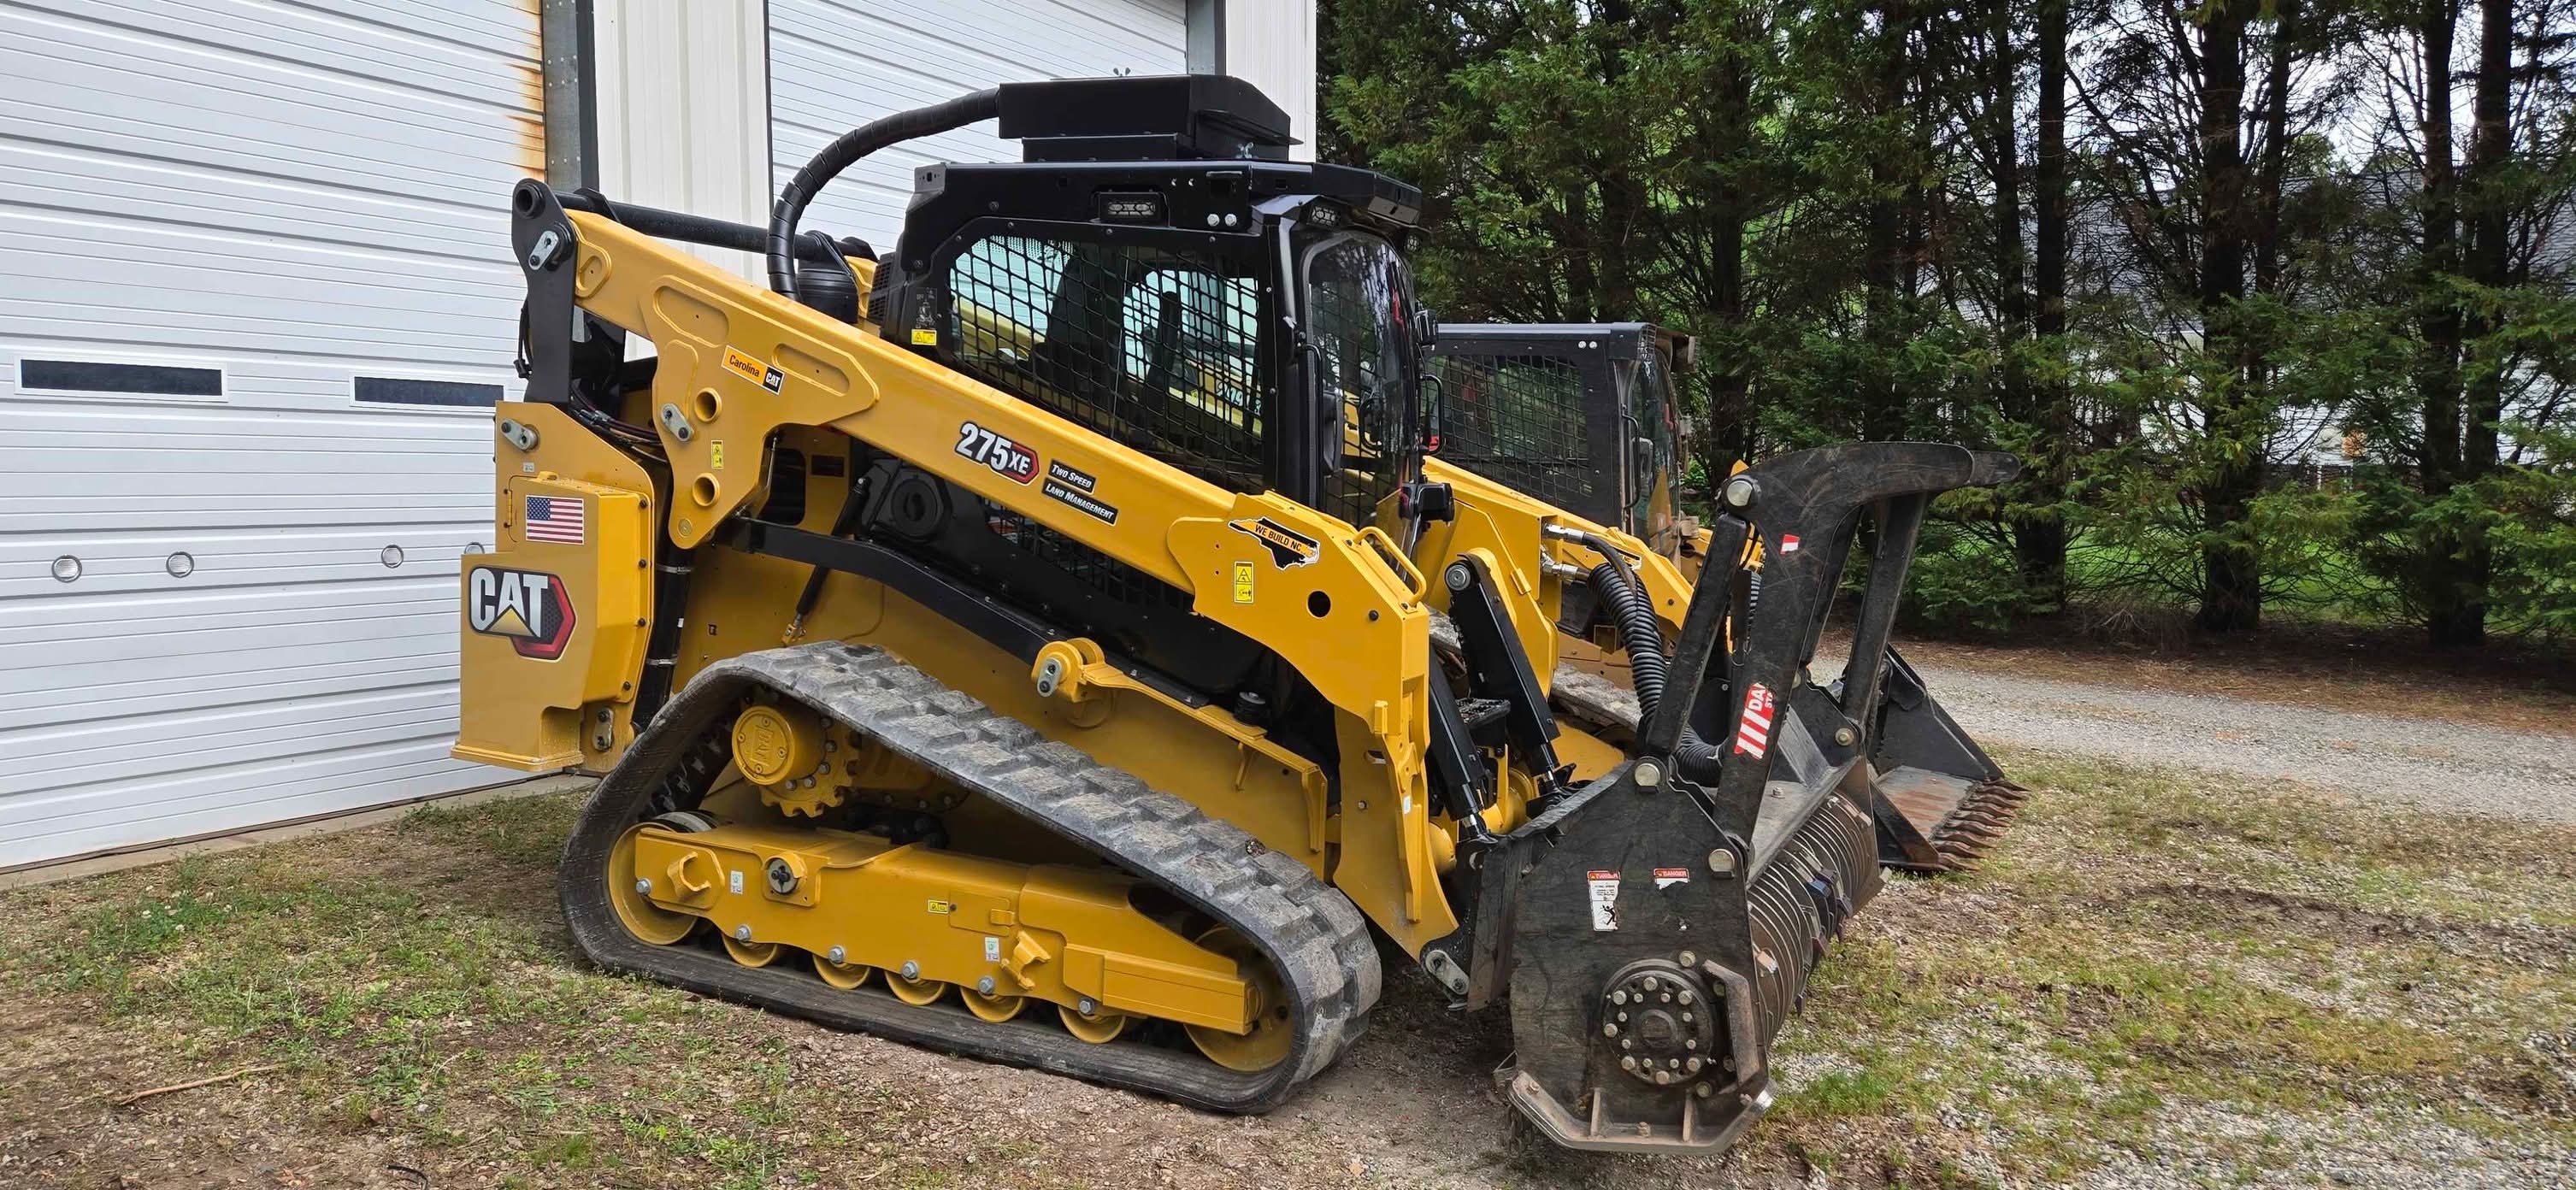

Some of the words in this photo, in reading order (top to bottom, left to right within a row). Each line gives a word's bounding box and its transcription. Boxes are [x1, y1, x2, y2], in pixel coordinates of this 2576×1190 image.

[729, 354, 760, 378] Carolina
[765, 372, 781, 387] CAT
[1254, 523, 1268, 537] WE
[1268, 530, 1290, 548] BUILD
[1290, 539, 1302, 552] NC
[469, 567, 549, 639] CAT
